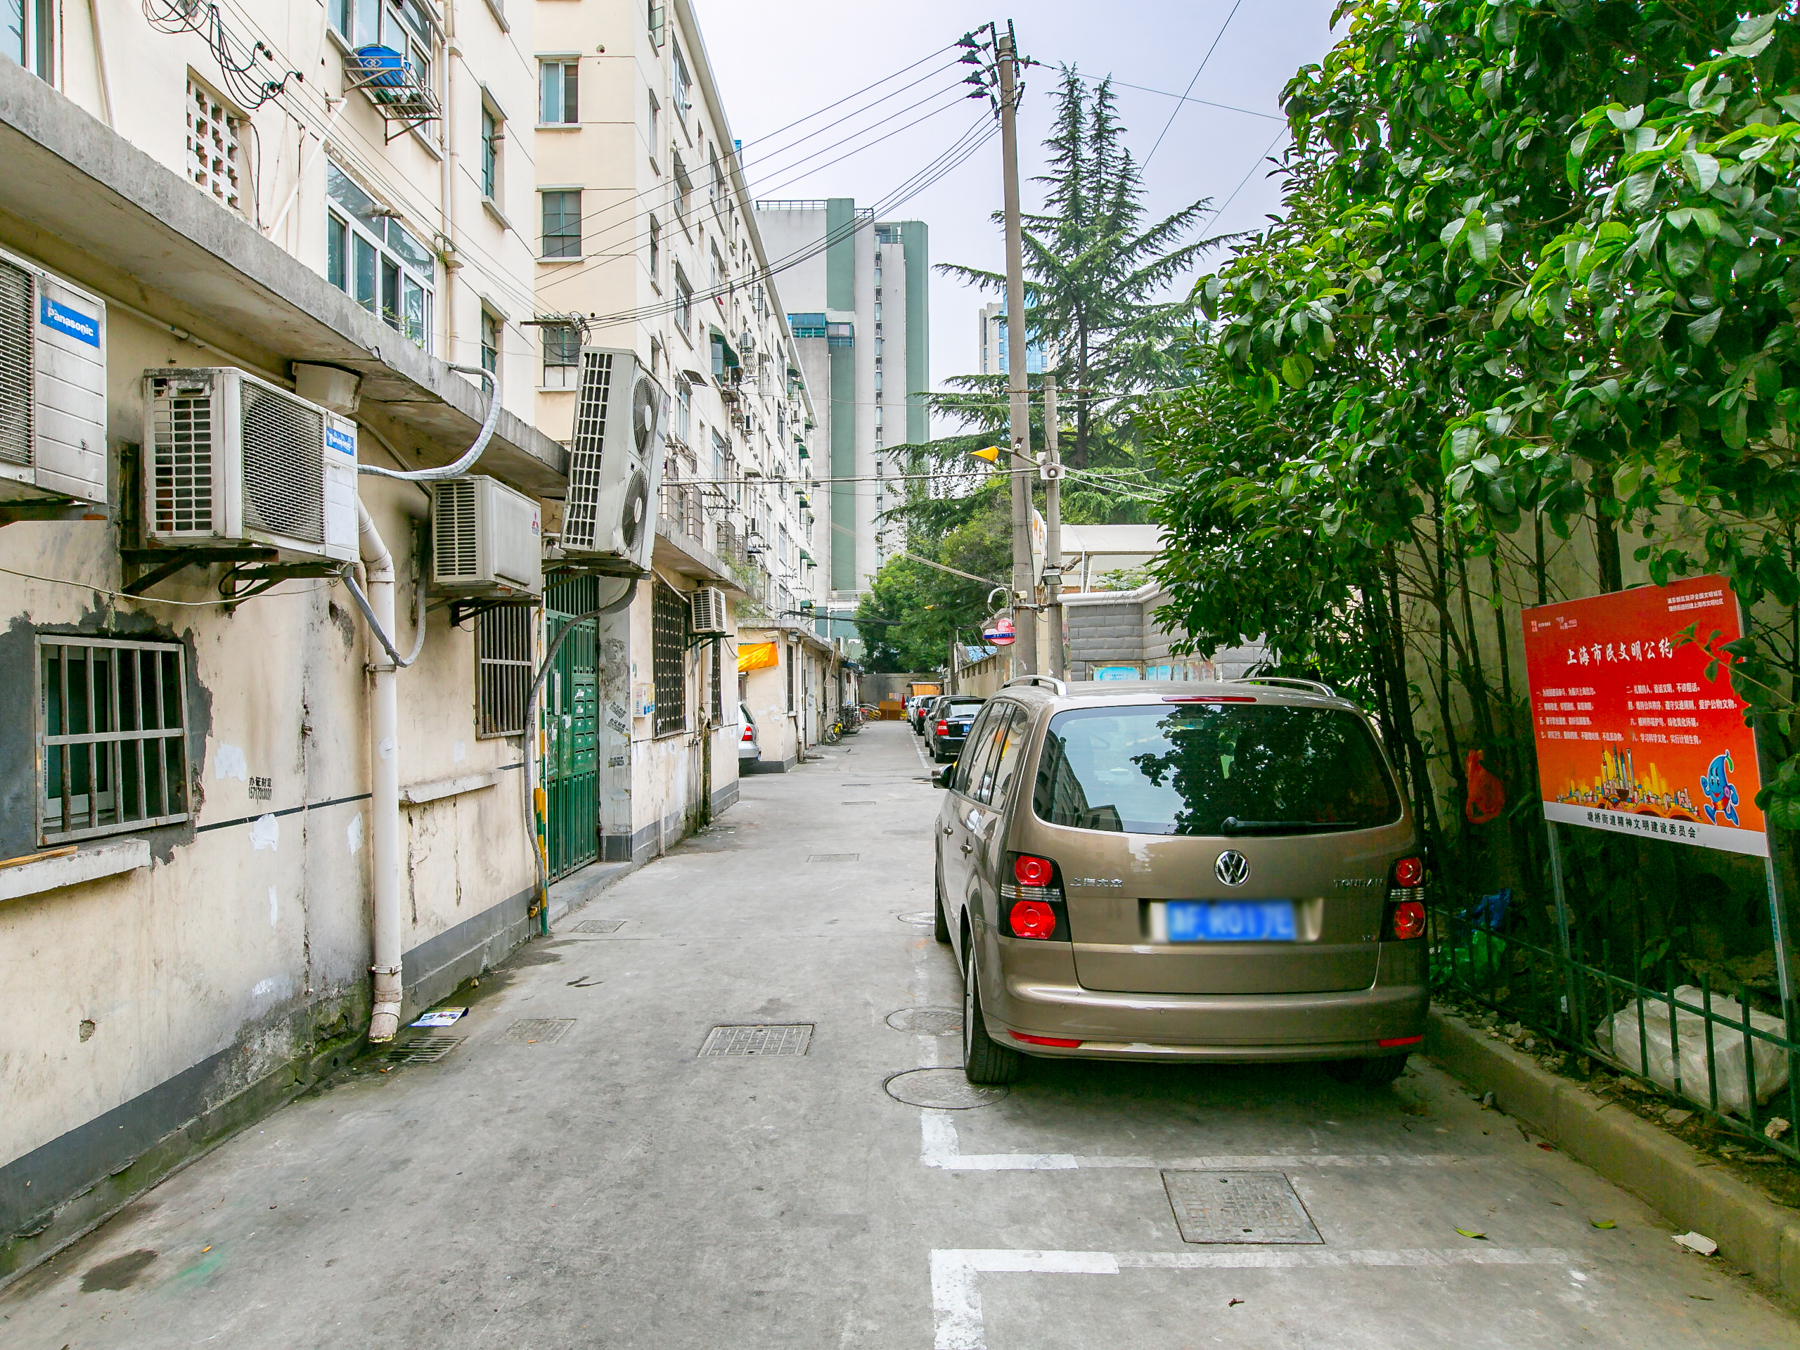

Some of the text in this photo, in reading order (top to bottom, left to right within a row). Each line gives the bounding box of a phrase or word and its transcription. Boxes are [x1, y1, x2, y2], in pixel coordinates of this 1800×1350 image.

[47, 307, 94, 337] Panasonic
[1566, 637, 1673, 667] 上海市民文明公约
[1587, 811, 1696, 839] 塘桥街道精神文明建设委员会
[1333, 878, 1384, 888] TOURAN
